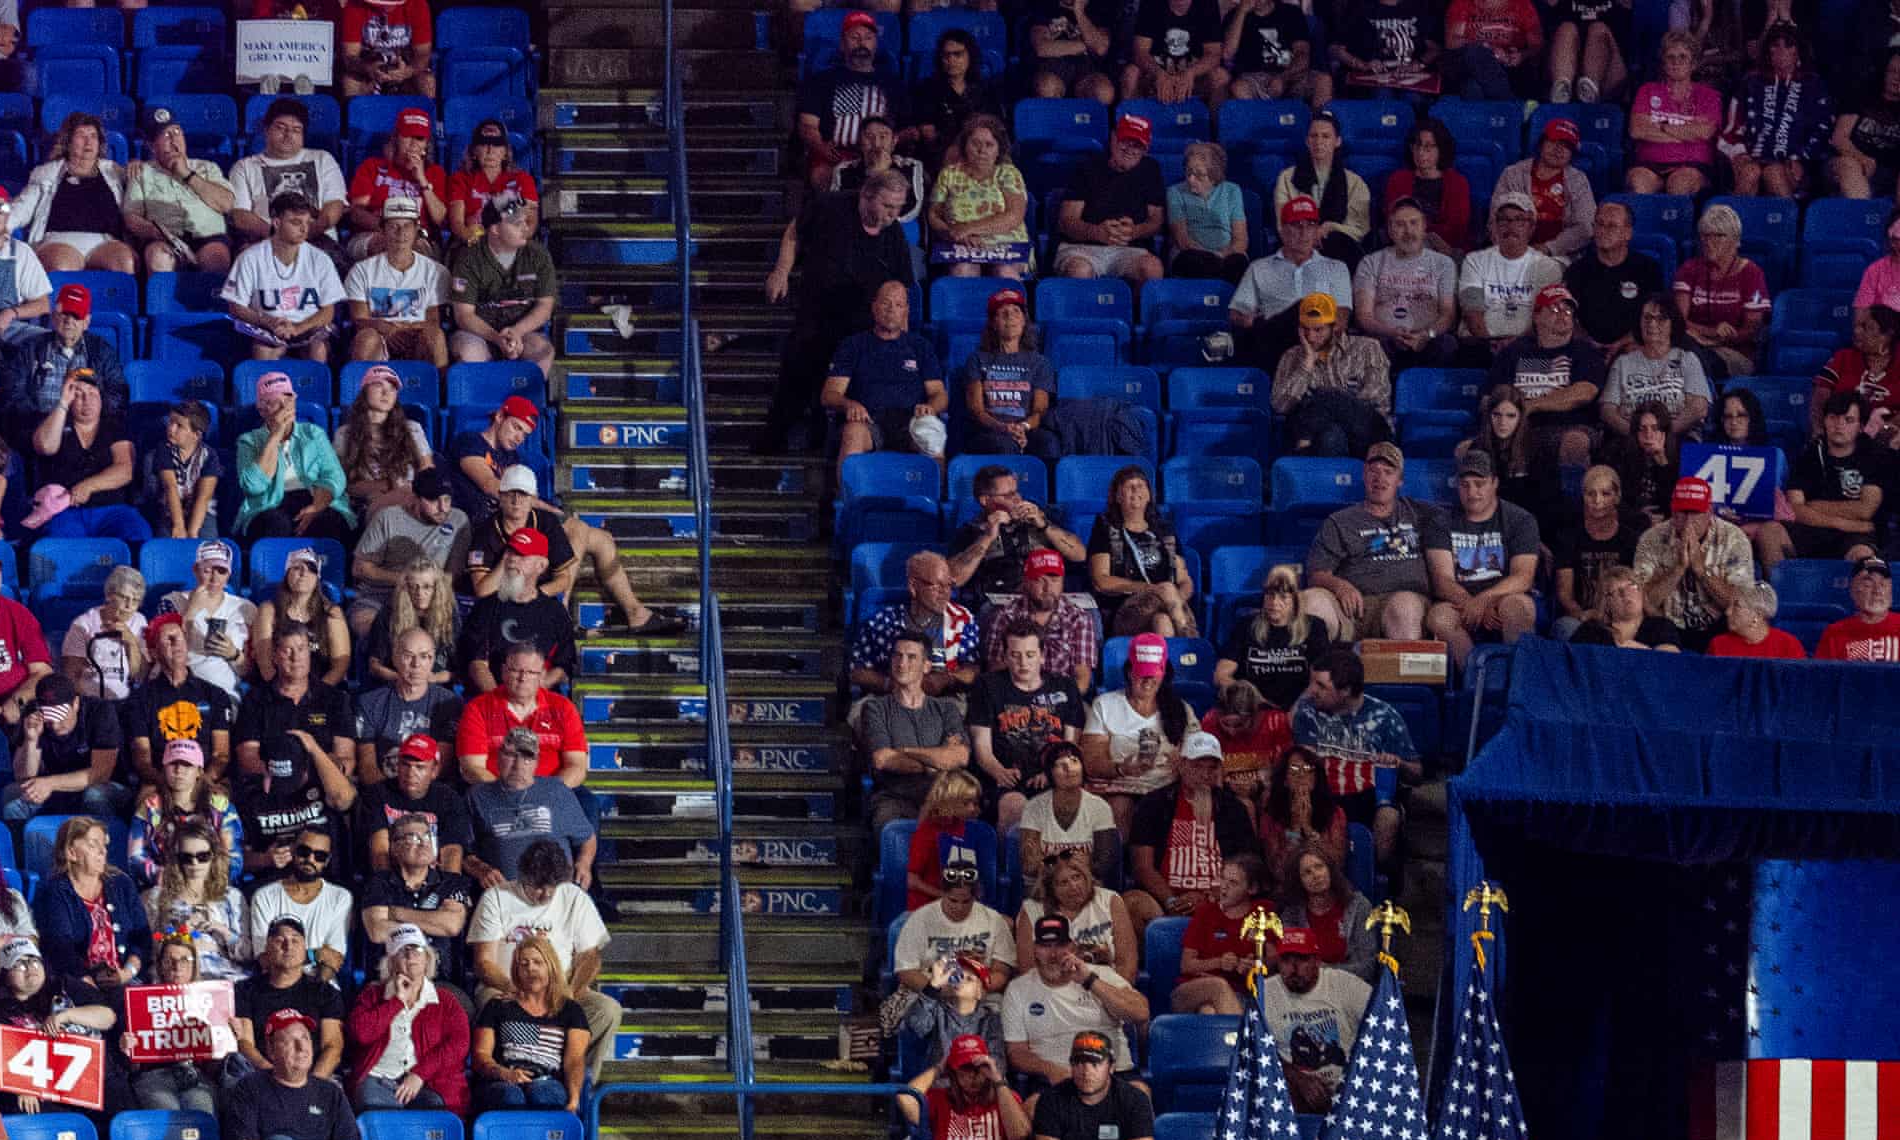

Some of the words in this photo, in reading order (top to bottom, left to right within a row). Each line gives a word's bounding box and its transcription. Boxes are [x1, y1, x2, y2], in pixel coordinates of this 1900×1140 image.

[243, 42, 276, 52] MAKE
[277, 41, 328, 53] AMERICA
[248, 53, 286, 64] GREAT
[288, 53, 320, 64] AGAIN
[259, 286, 321, 312] USA
[622, 426, 668, 444] PNC
[1693, 455, 1766, 505] 47
[761, 749, 808, 768] PNC
[257, 801, 323, 828] TRUMP
[763, 841, 814, 858] PNC
[767, 891, 818, 912] PNC
[147, 993, 213, 1014] BRING
[150, 1010, 211, 1029] BACK
[136, 1026, 234, 1052] TRUMP
[7, 1039, 92, 1091] 47
